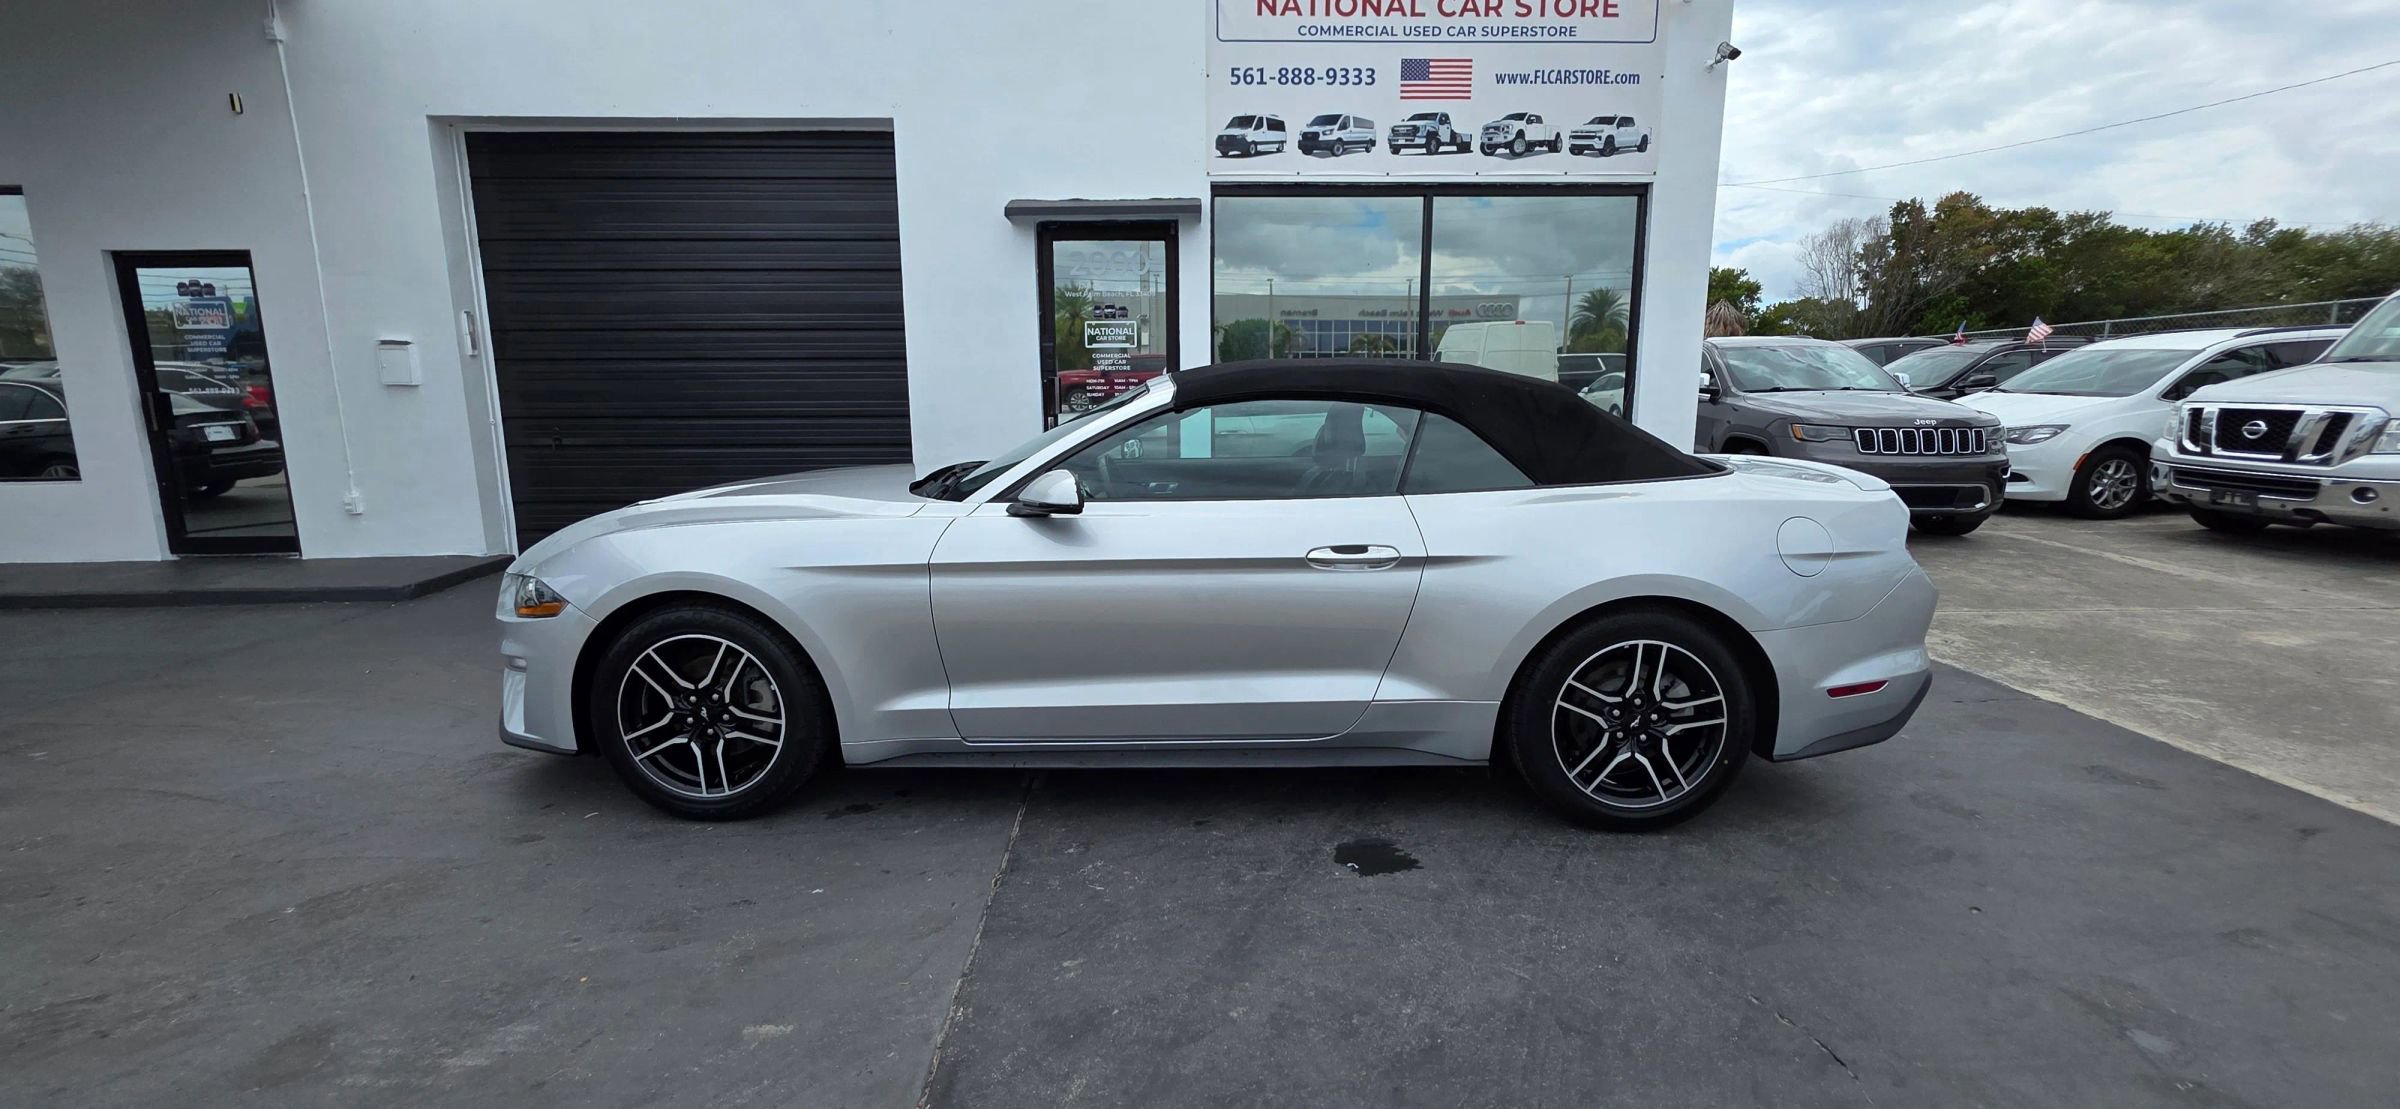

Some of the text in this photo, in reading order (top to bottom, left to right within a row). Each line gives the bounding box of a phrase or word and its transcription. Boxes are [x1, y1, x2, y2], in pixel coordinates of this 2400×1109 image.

[1257, 0, 1620, 17] NATIONAL CAR STORE
[1298, 25, 1577, 37] COMMERCIAL USED CAR SUPERSTORE
[1229, 67, 1640, 86] 561-888-9333 www.FLCARSTORE.com
[1087, 327, 1134, 336] NATIONAL
